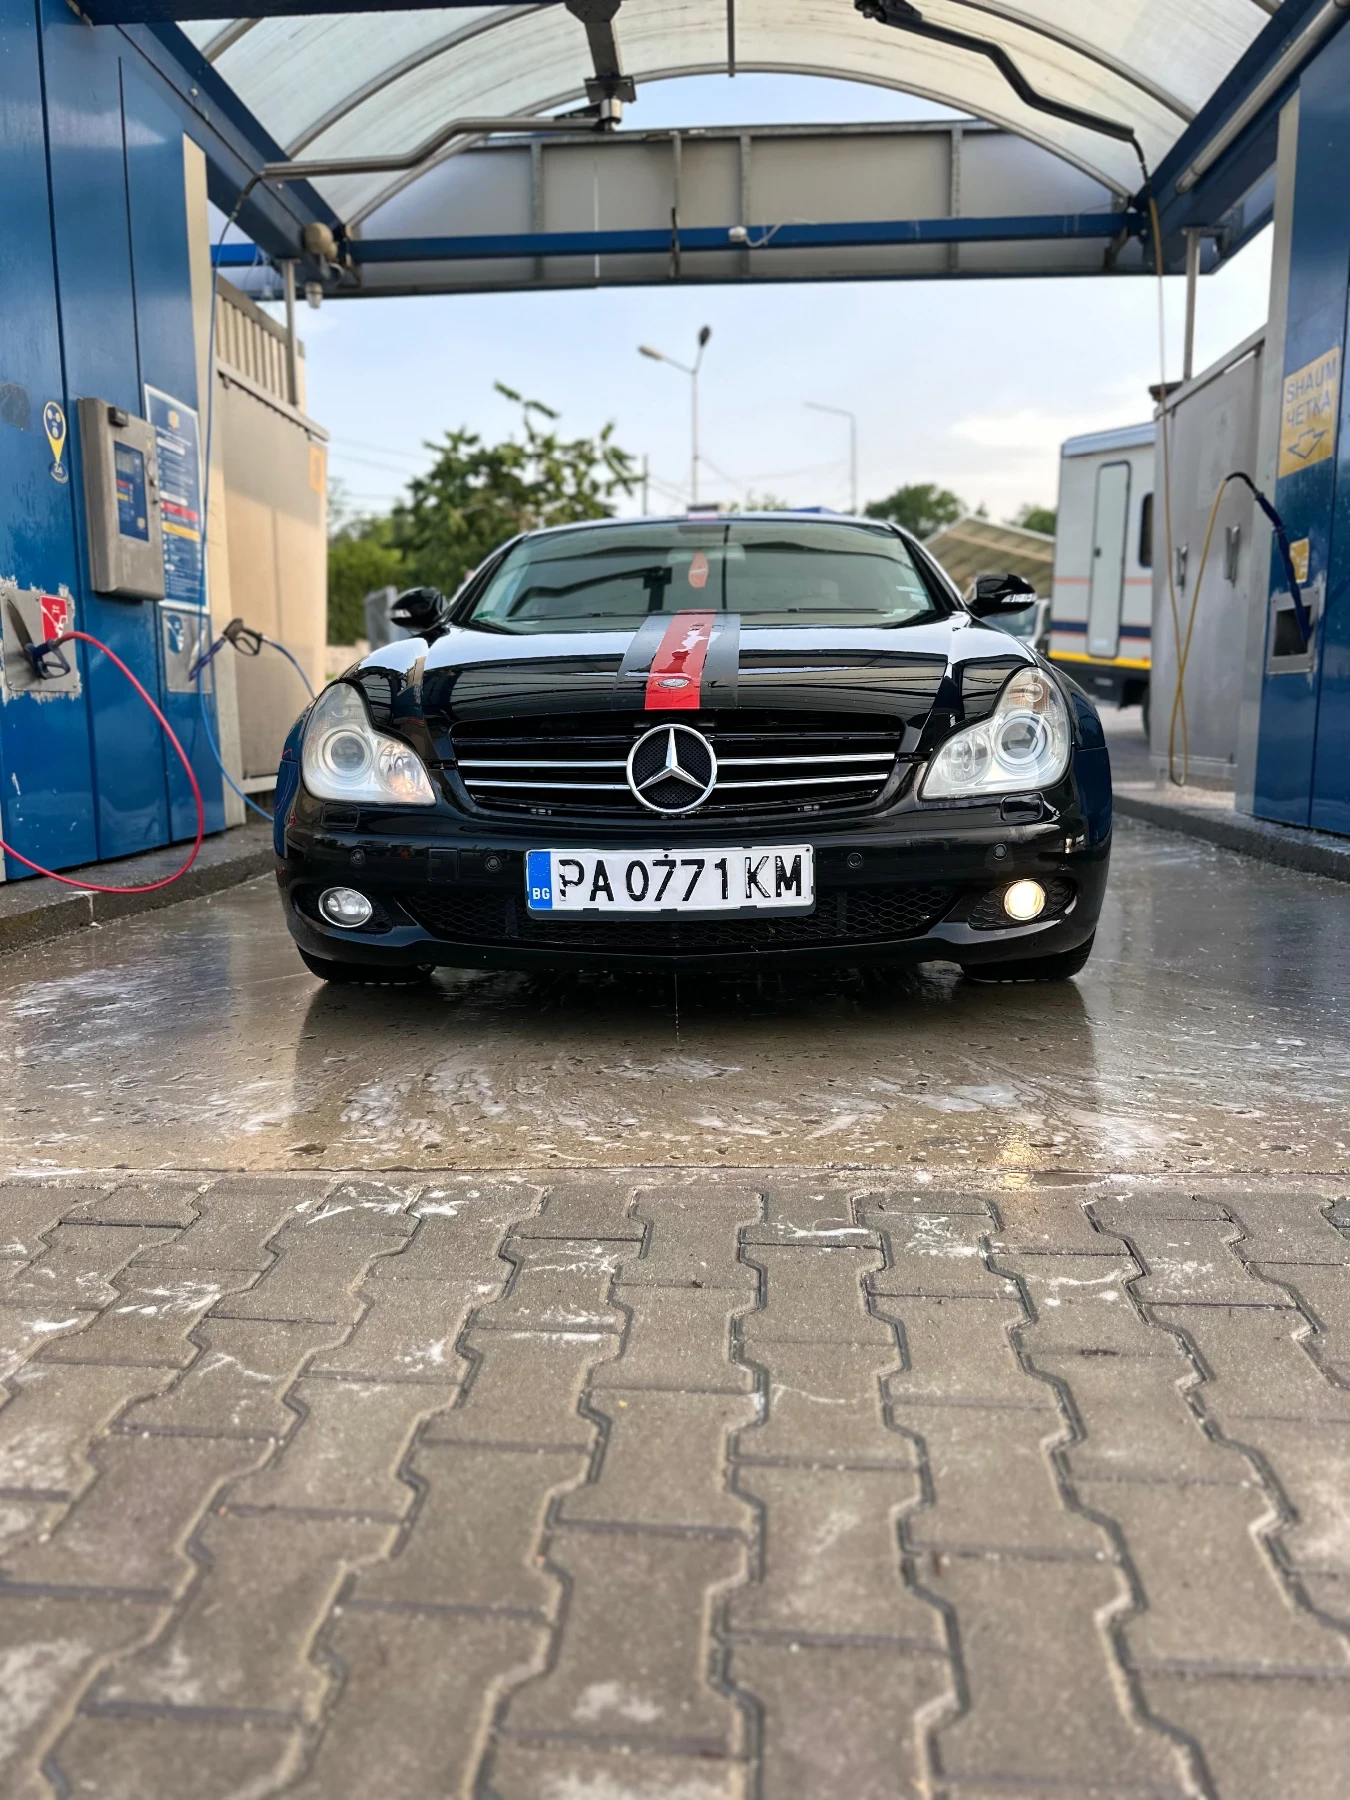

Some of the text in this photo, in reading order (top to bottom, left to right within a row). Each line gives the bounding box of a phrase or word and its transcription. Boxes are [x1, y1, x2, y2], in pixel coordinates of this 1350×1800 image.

[1286, 358, 1336, 404] SHAUM
[1286, 389, 1331, 427] ЧЕТКА
[532, 887, 550, 900] BG
